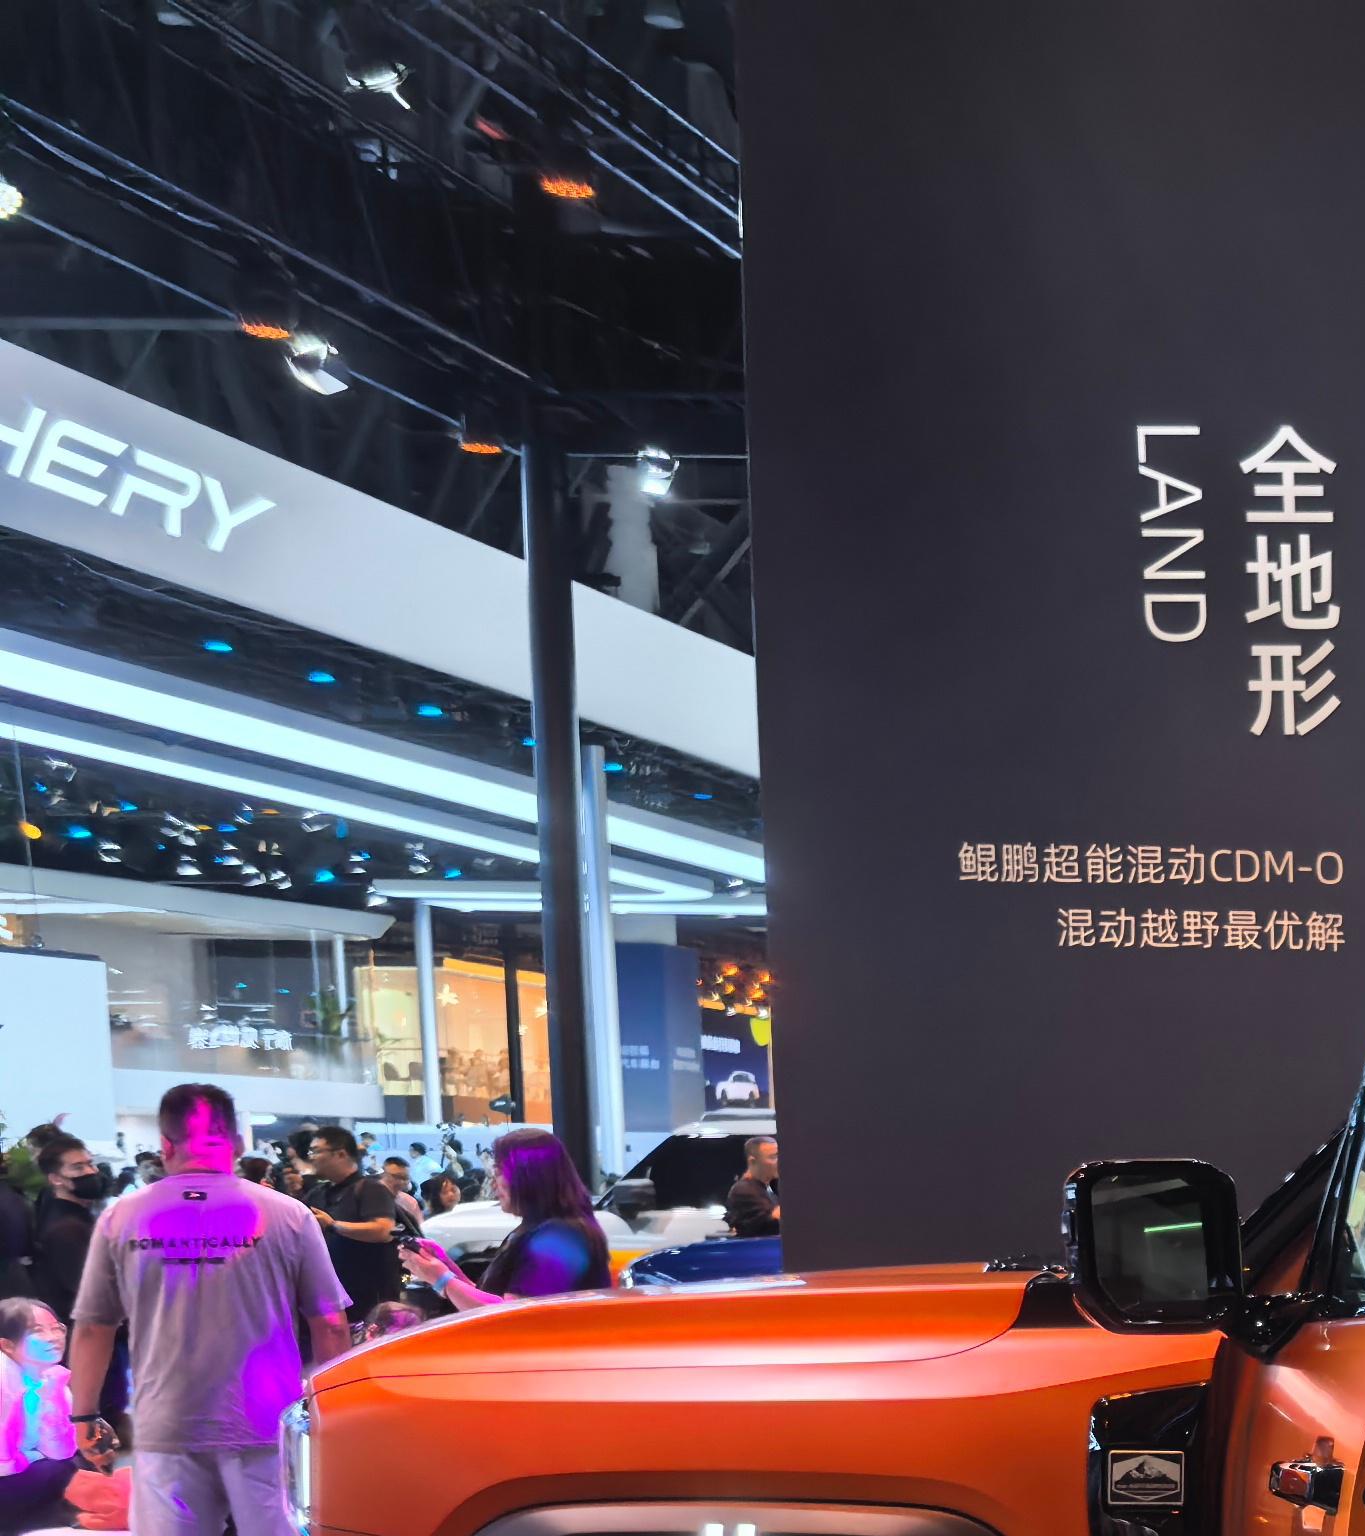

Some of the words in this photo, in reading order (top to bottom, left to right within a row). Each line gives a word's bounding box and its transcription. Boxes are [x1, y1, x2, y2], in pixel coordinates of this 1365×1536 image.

[1136, 425, 1207, 643] LAND
[1239, 425, 1342, 736] 全地形
[957, 841, 1345, 886] 鲲鹏超能混动CDM-O
[1057, 907, 1346, 954] 混动越野最优解
